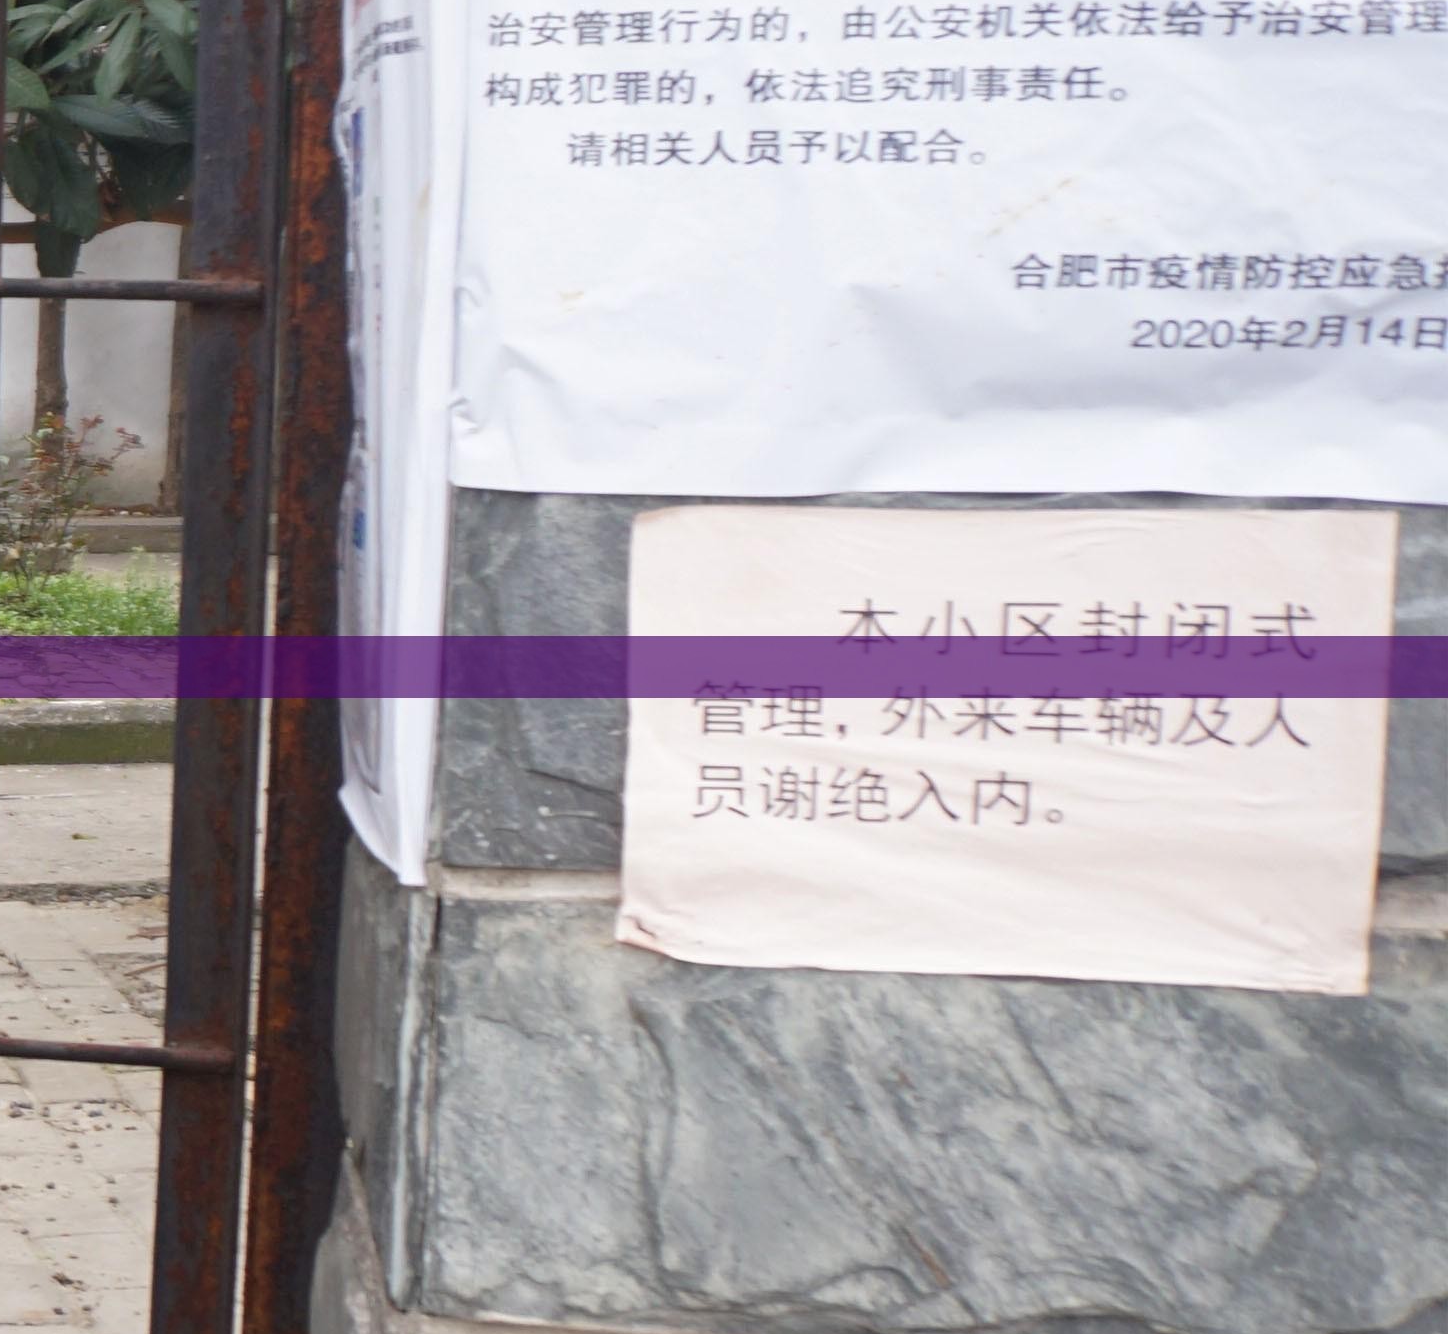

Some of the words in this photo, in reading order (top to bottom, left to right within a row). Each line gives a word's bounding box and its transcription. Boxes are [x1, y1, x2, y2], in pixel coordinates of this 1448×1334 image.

[484, 64, 1131, 108] 构成犯罪的，依法追究刑事责任。
[568, 129, 988, 168] 请相关人员予以配合。
[1131, 315, 1447, 353] 2020年2月14日
[838, 599, 1319, 665] 本小区封闭式
[692, 677, 1312, 750] 管理，外来车辆及人
[692, 765, 1067, 828] 员谢绝入内。
